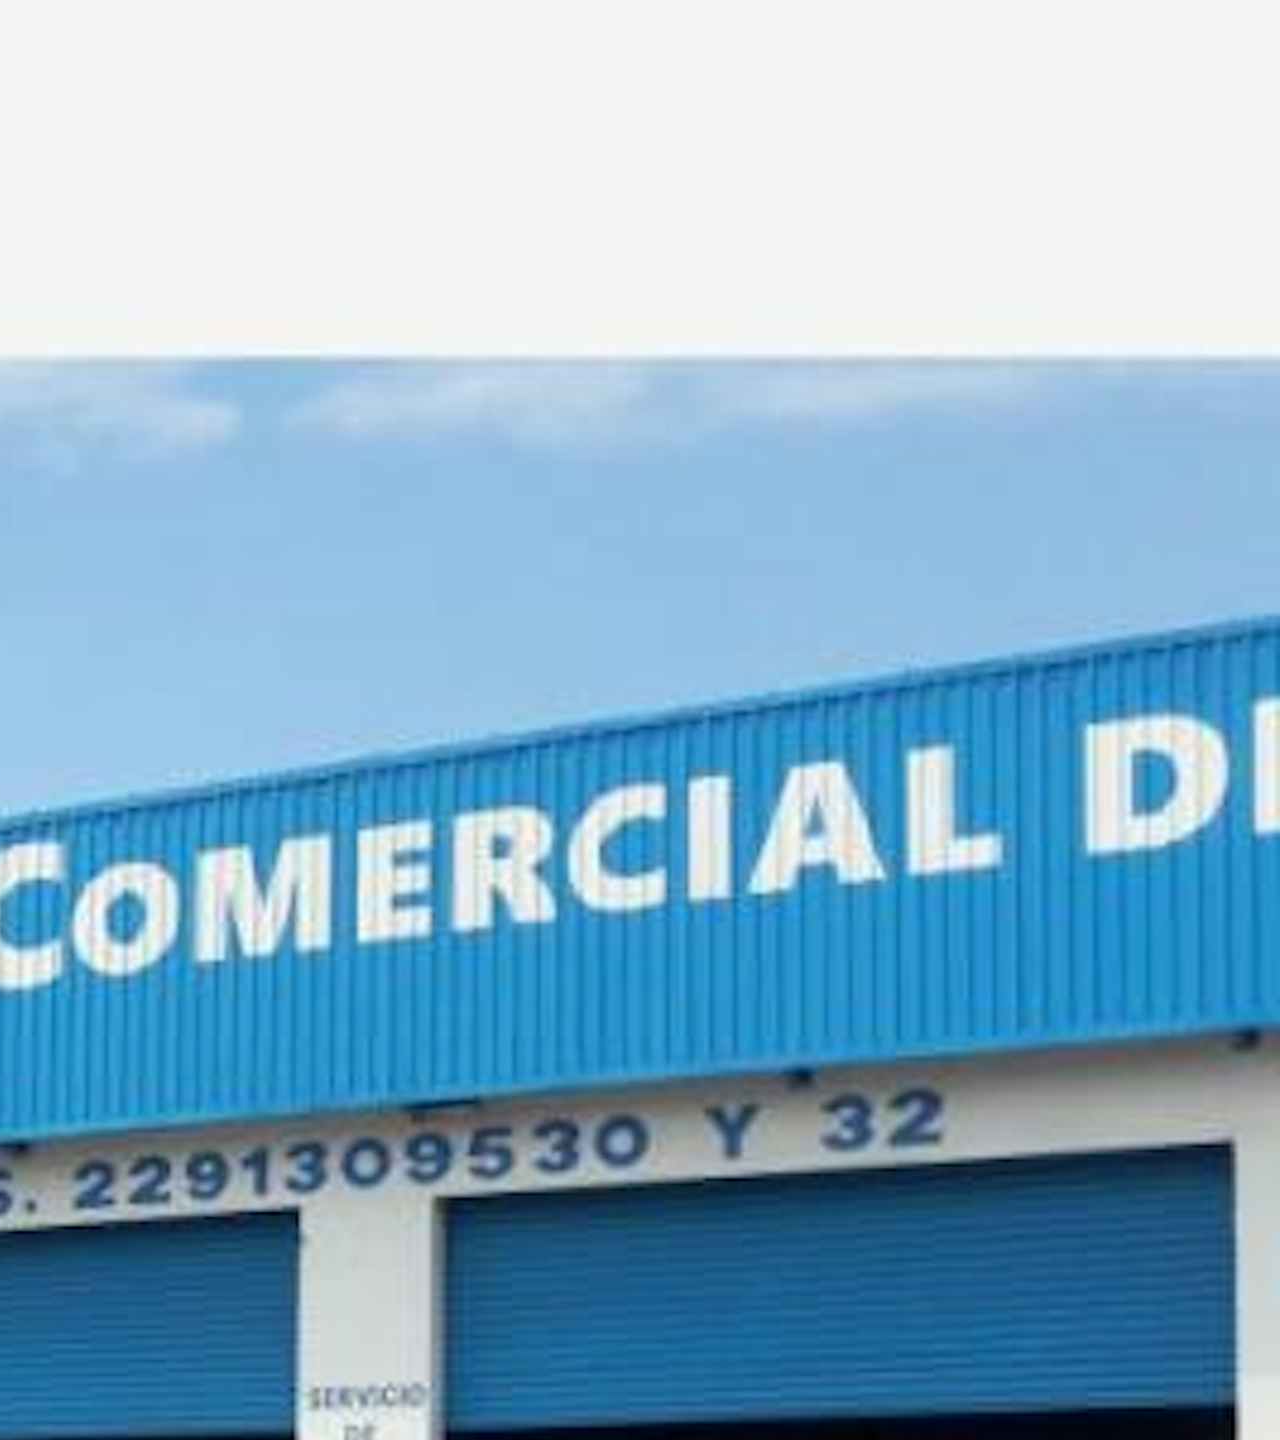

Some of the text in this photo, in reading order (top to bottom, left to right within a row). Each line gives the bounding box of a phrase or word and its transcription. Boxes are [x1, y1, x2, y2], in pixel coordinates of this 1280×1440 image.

[72, 1113, 650, 1213] 2291309530
[703, 1104, 758, 1160] Y
[821, 1088, 946, 1152] 32
[307, 1382, 429, 1411] SERVICIO
